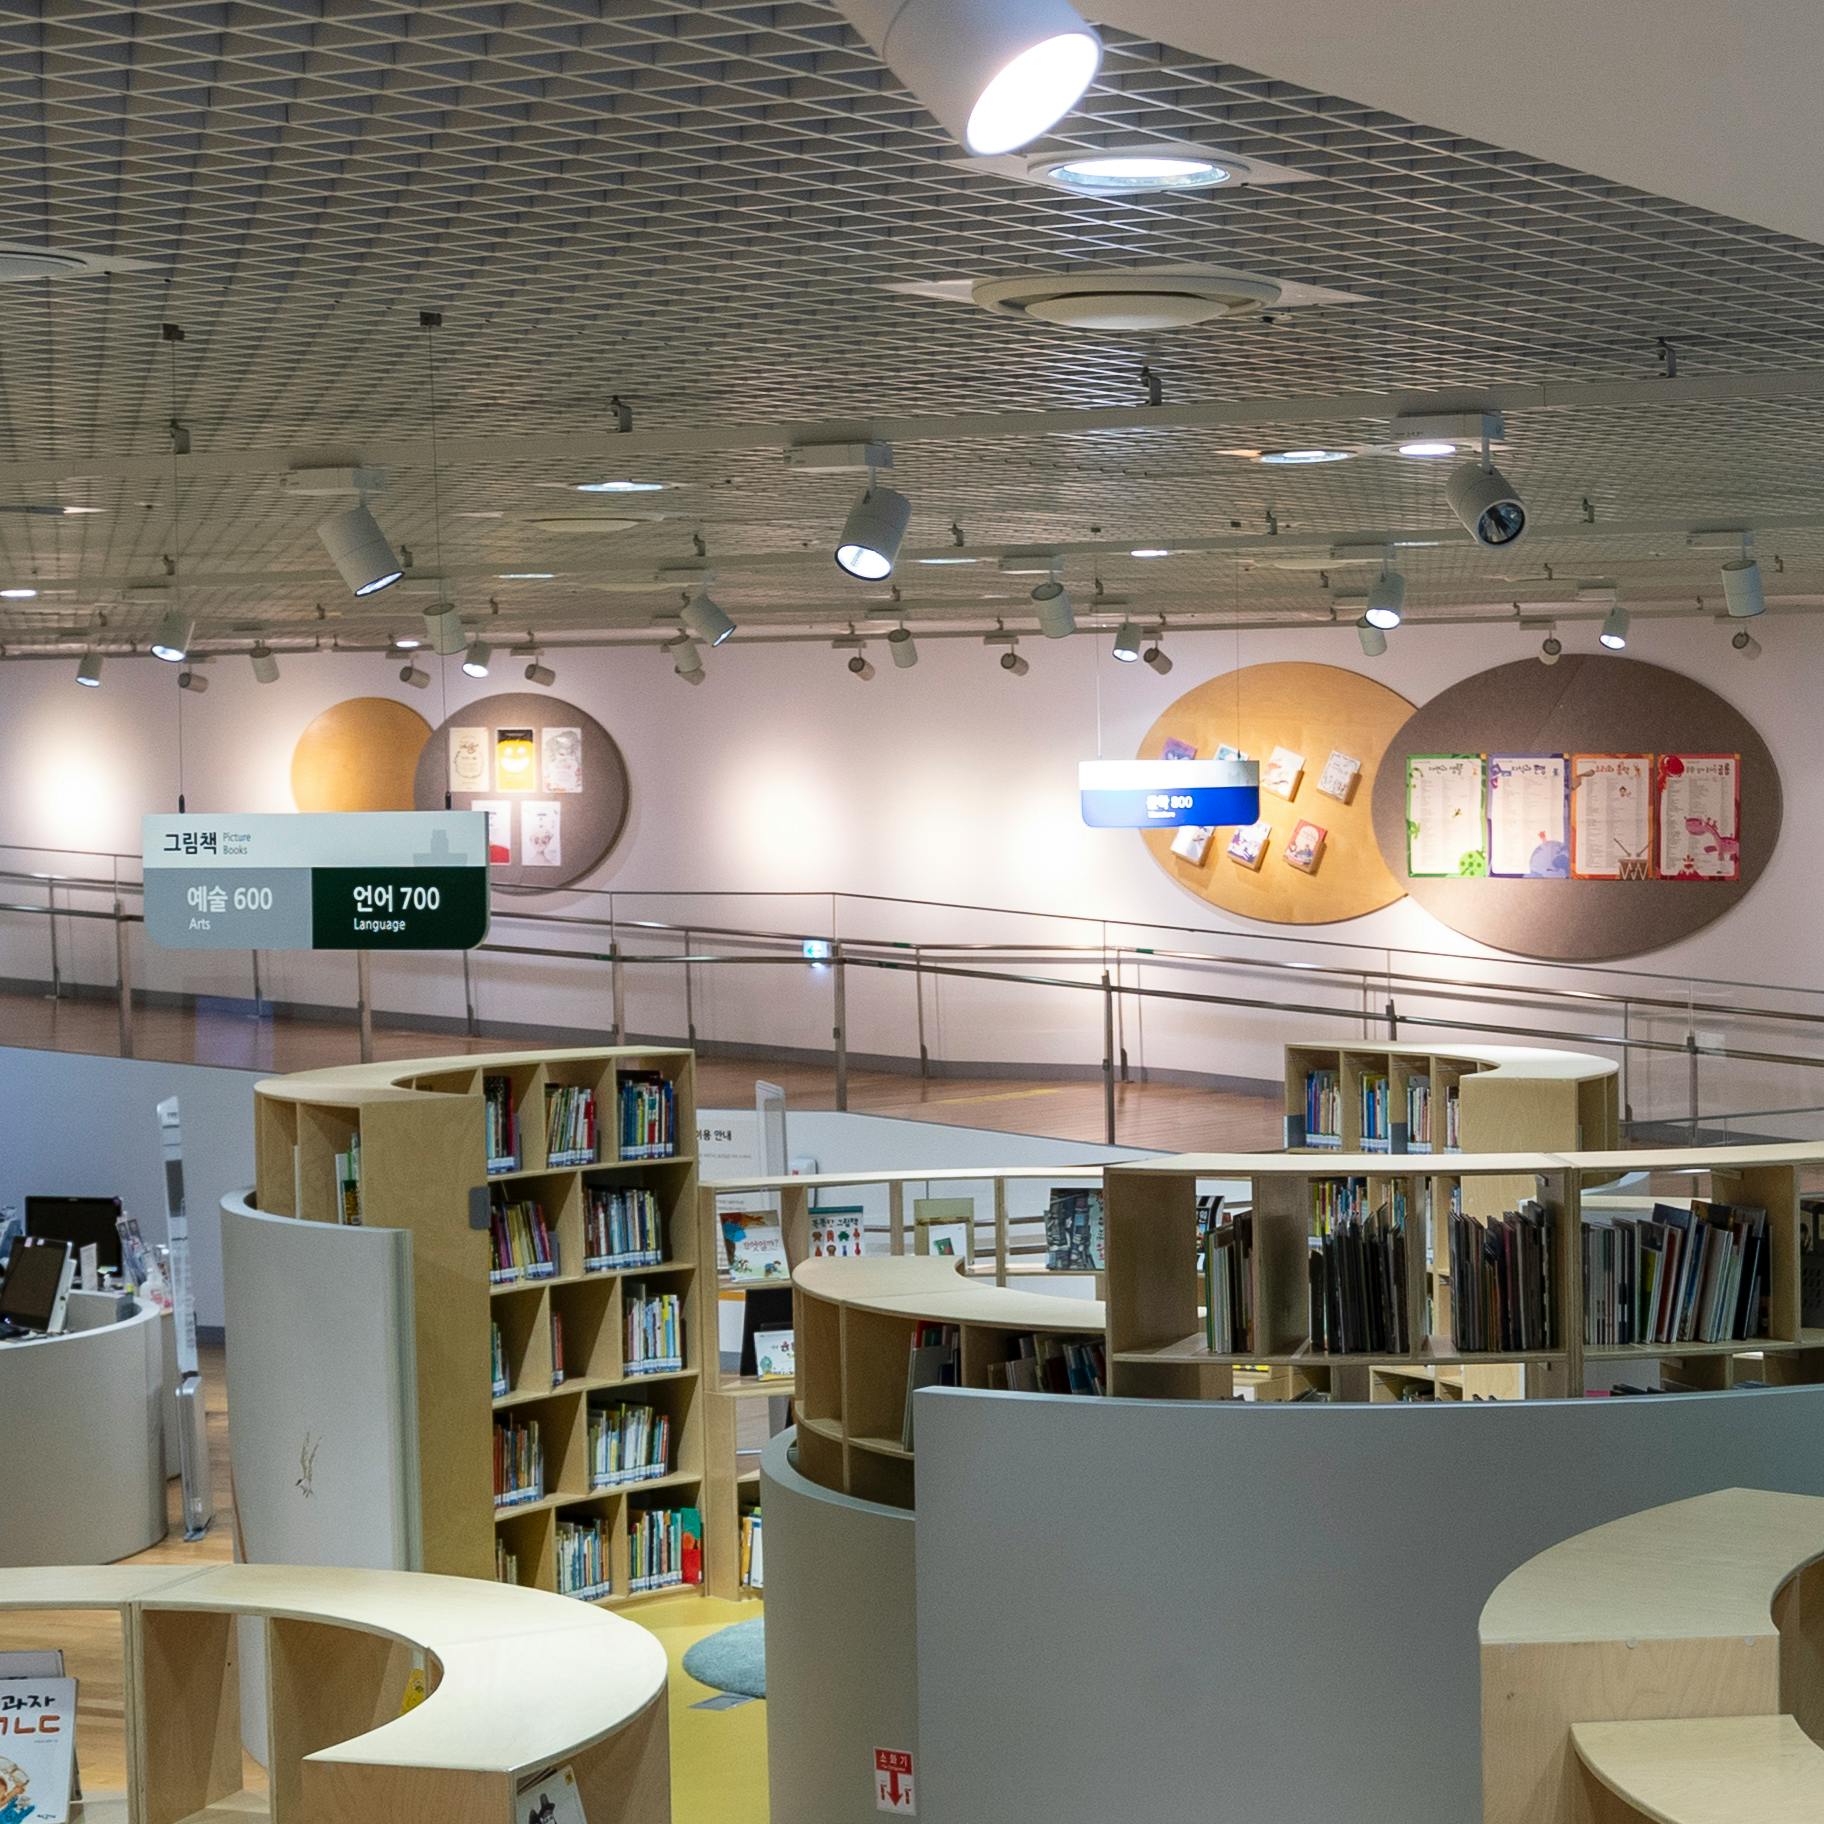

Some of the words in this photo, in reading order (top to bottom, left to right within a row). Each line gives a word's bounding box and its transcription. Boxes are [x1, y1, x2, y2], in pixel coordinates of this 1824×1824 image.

[163, 832, 217, 855] 그림책
[223, 832, 251, 843] Picture
[223, 845, 247, 855] Books
[187, 885, 228, 912] 예술
[234, 887, 273, 910] 600
[353, 885, 394, 912] 언어
[400, 887, 440, 910] 700
[188, 918, 211, 930] Arts
[353, 918, 406, 933] Language
[714, 1130, 732, 1141] 안내
[1, 1695, 55, 1711] 과자
[880, 1752, 907, 1768] 소화기
